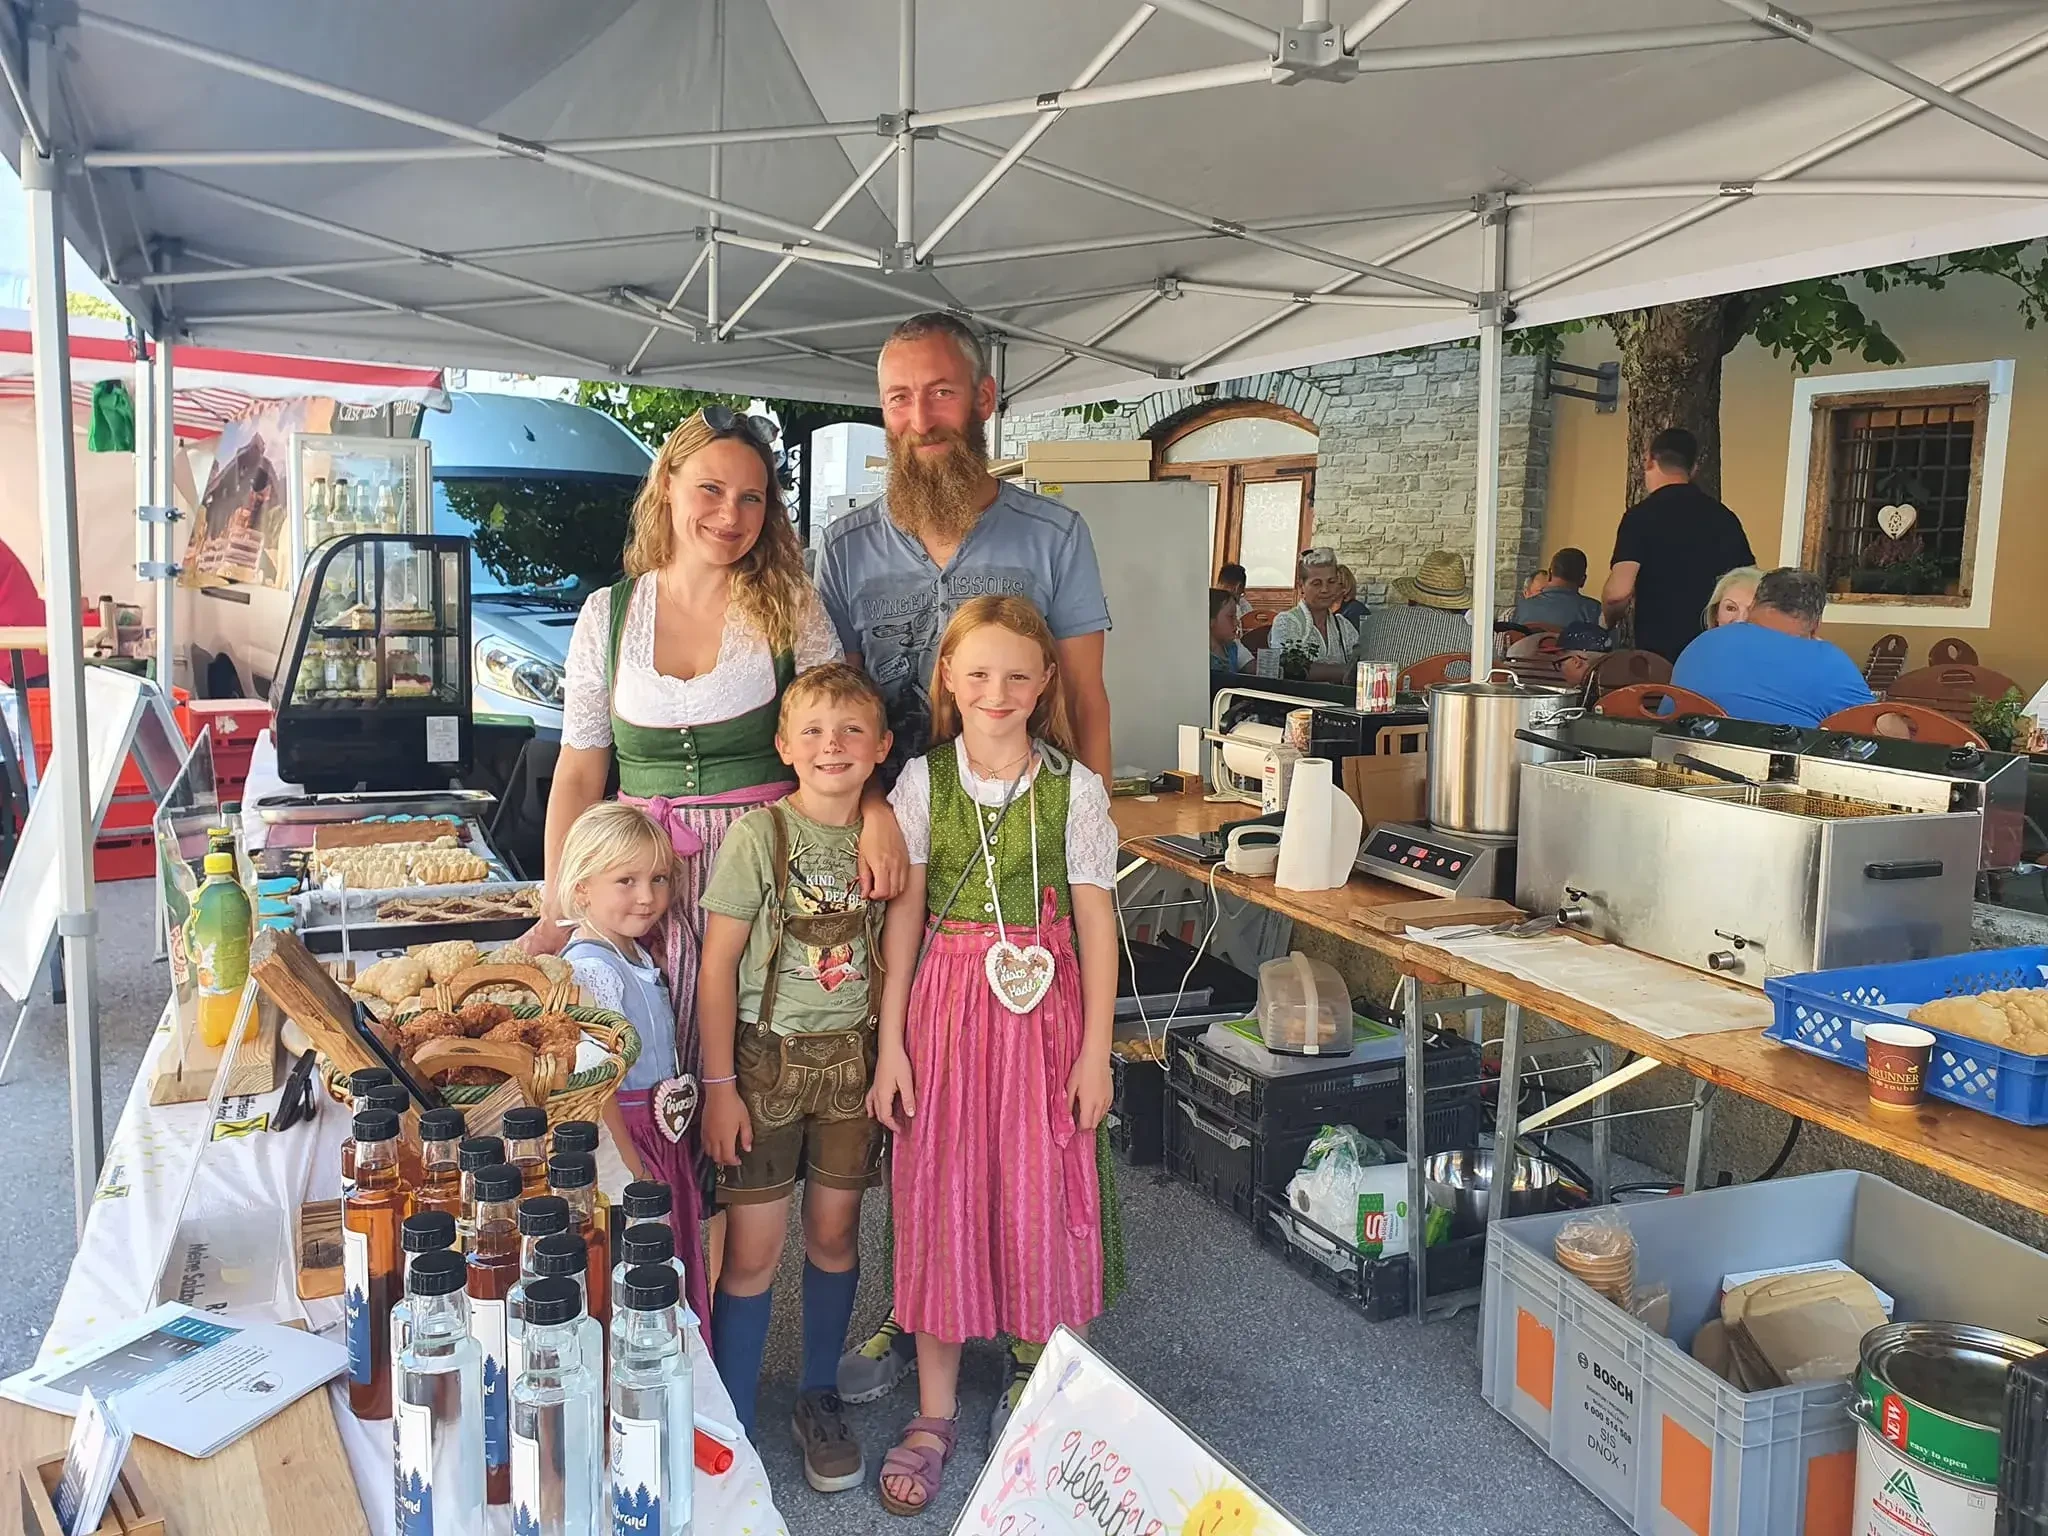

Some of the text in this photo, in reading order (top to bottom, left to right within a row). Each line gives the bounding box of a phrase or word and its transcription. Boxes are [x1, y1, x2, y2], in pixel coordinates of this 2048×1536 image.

[865, 575, 1024, 620] WINGED ISSORS
[806, 874, 835, 886] KIND
[847, 894, 862, 906] BE
[1869, 1065, 1920, 1083] BRUNNER
[1593, 1362, 1634, 1405] BOSCH
[1590, 1406, 1604, 1421] 000
[1885, 1398, 1902, 1441] NEW
[1587, 1434, 1620, 1469] DNOX
[1600, 1428, 1617, 1449] SIS
[1909, 1441, 1968, 1470] easy to open
[1878, 1491, 1912, 1523] Frying
